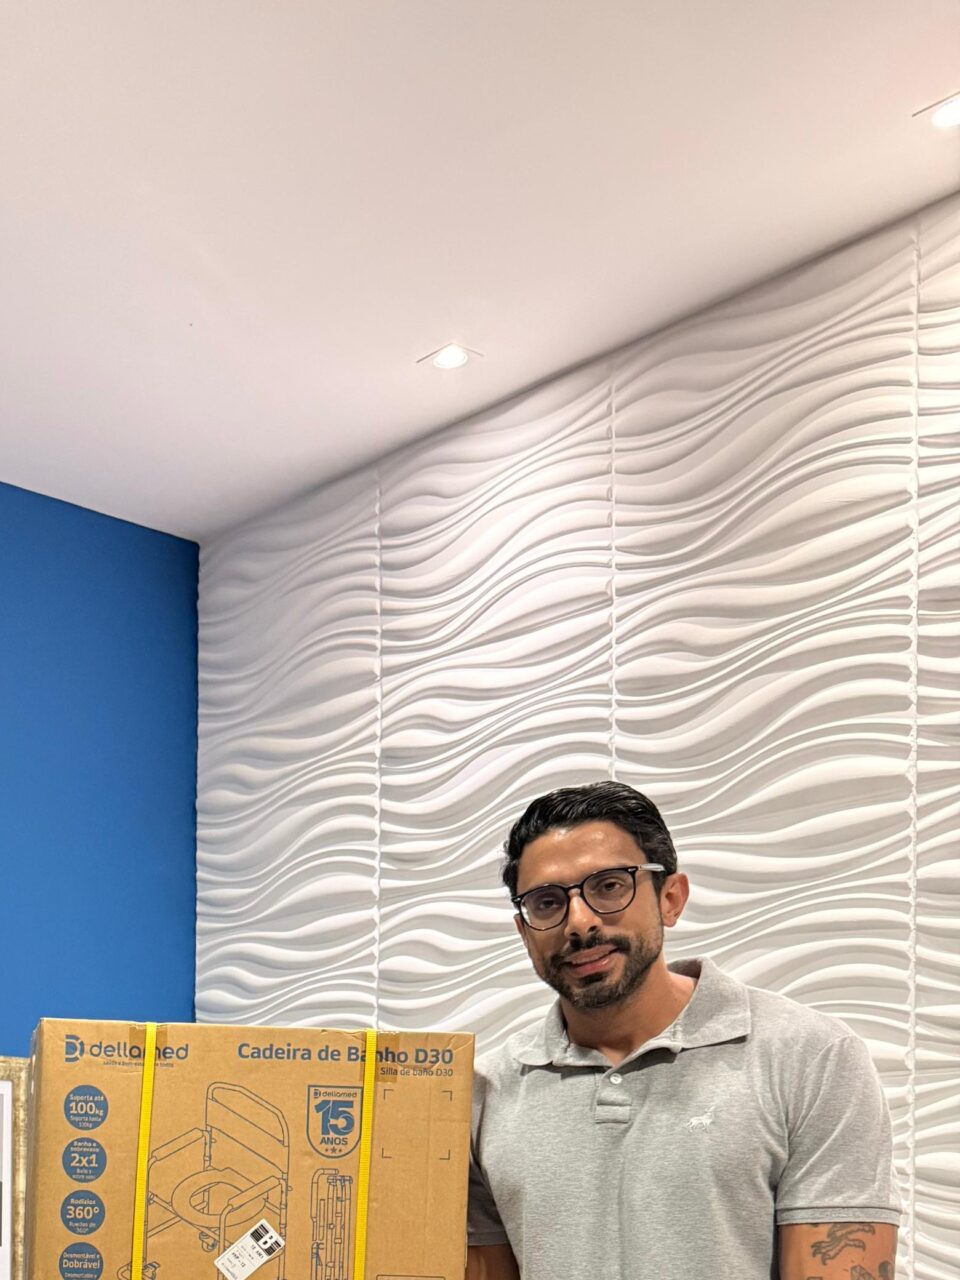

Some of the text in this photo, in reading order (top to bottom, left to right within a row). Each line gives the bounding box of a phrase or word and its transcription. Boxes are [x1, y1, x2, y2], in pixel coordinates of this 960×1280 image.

[238, 1043, 311, 1061] Cadeira
[317, 1045, 341, 1061] de
[414, 1048, 453, 1064] D30
[380, 1066, 397, 1076] Silla
[400, 1067, 410, 1076] de
[436, 1068, 453, 1077] D30
[314, 1100, 355, 1136] 15
[320, 1137, 348, 1145] ANOS
[70, 1153, 98, 1167] 2x1
[63, 1259, 100, 1269] Dobrável
